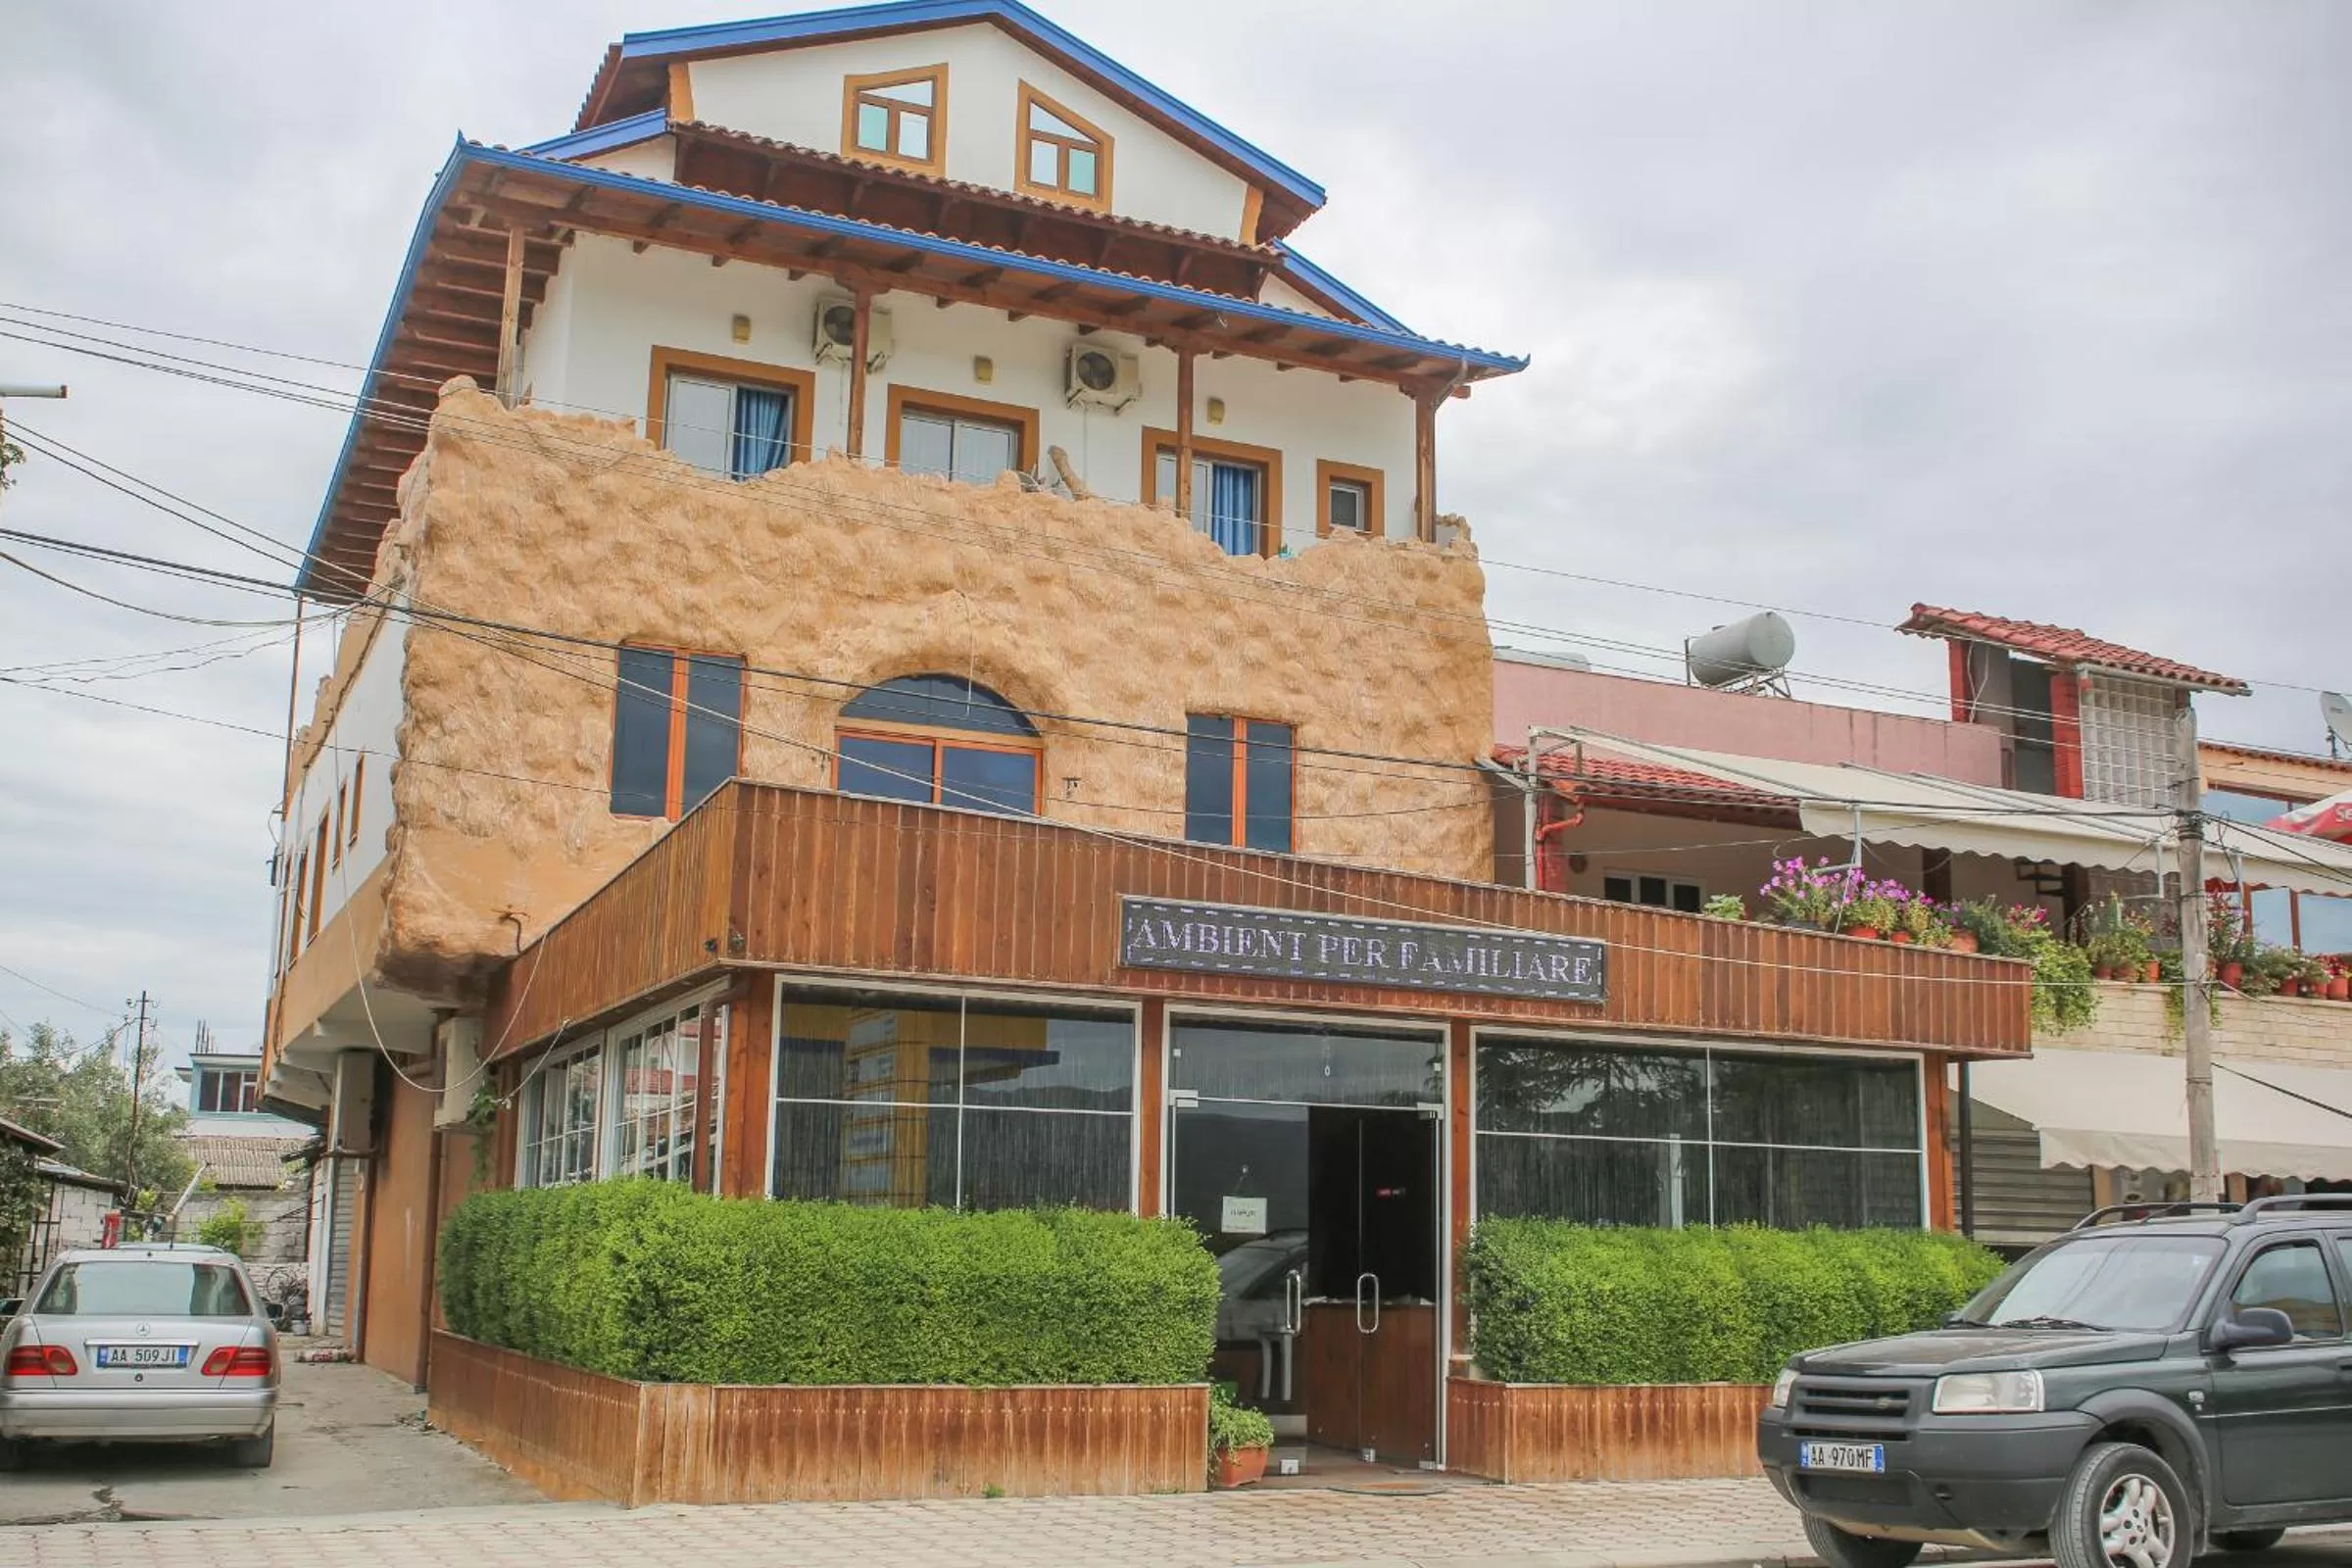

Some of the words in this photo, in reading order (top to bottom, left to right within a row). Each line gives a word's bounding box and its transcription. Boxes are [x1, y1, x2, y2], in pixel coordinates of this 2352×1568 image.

[1130, 918, 1306, 961] AMBIENT
[1318, 934, 1390, 968] PER
[1398, 942, 1592, 985] FAMILIARE
[111, 1348, 127, 1362] AA
